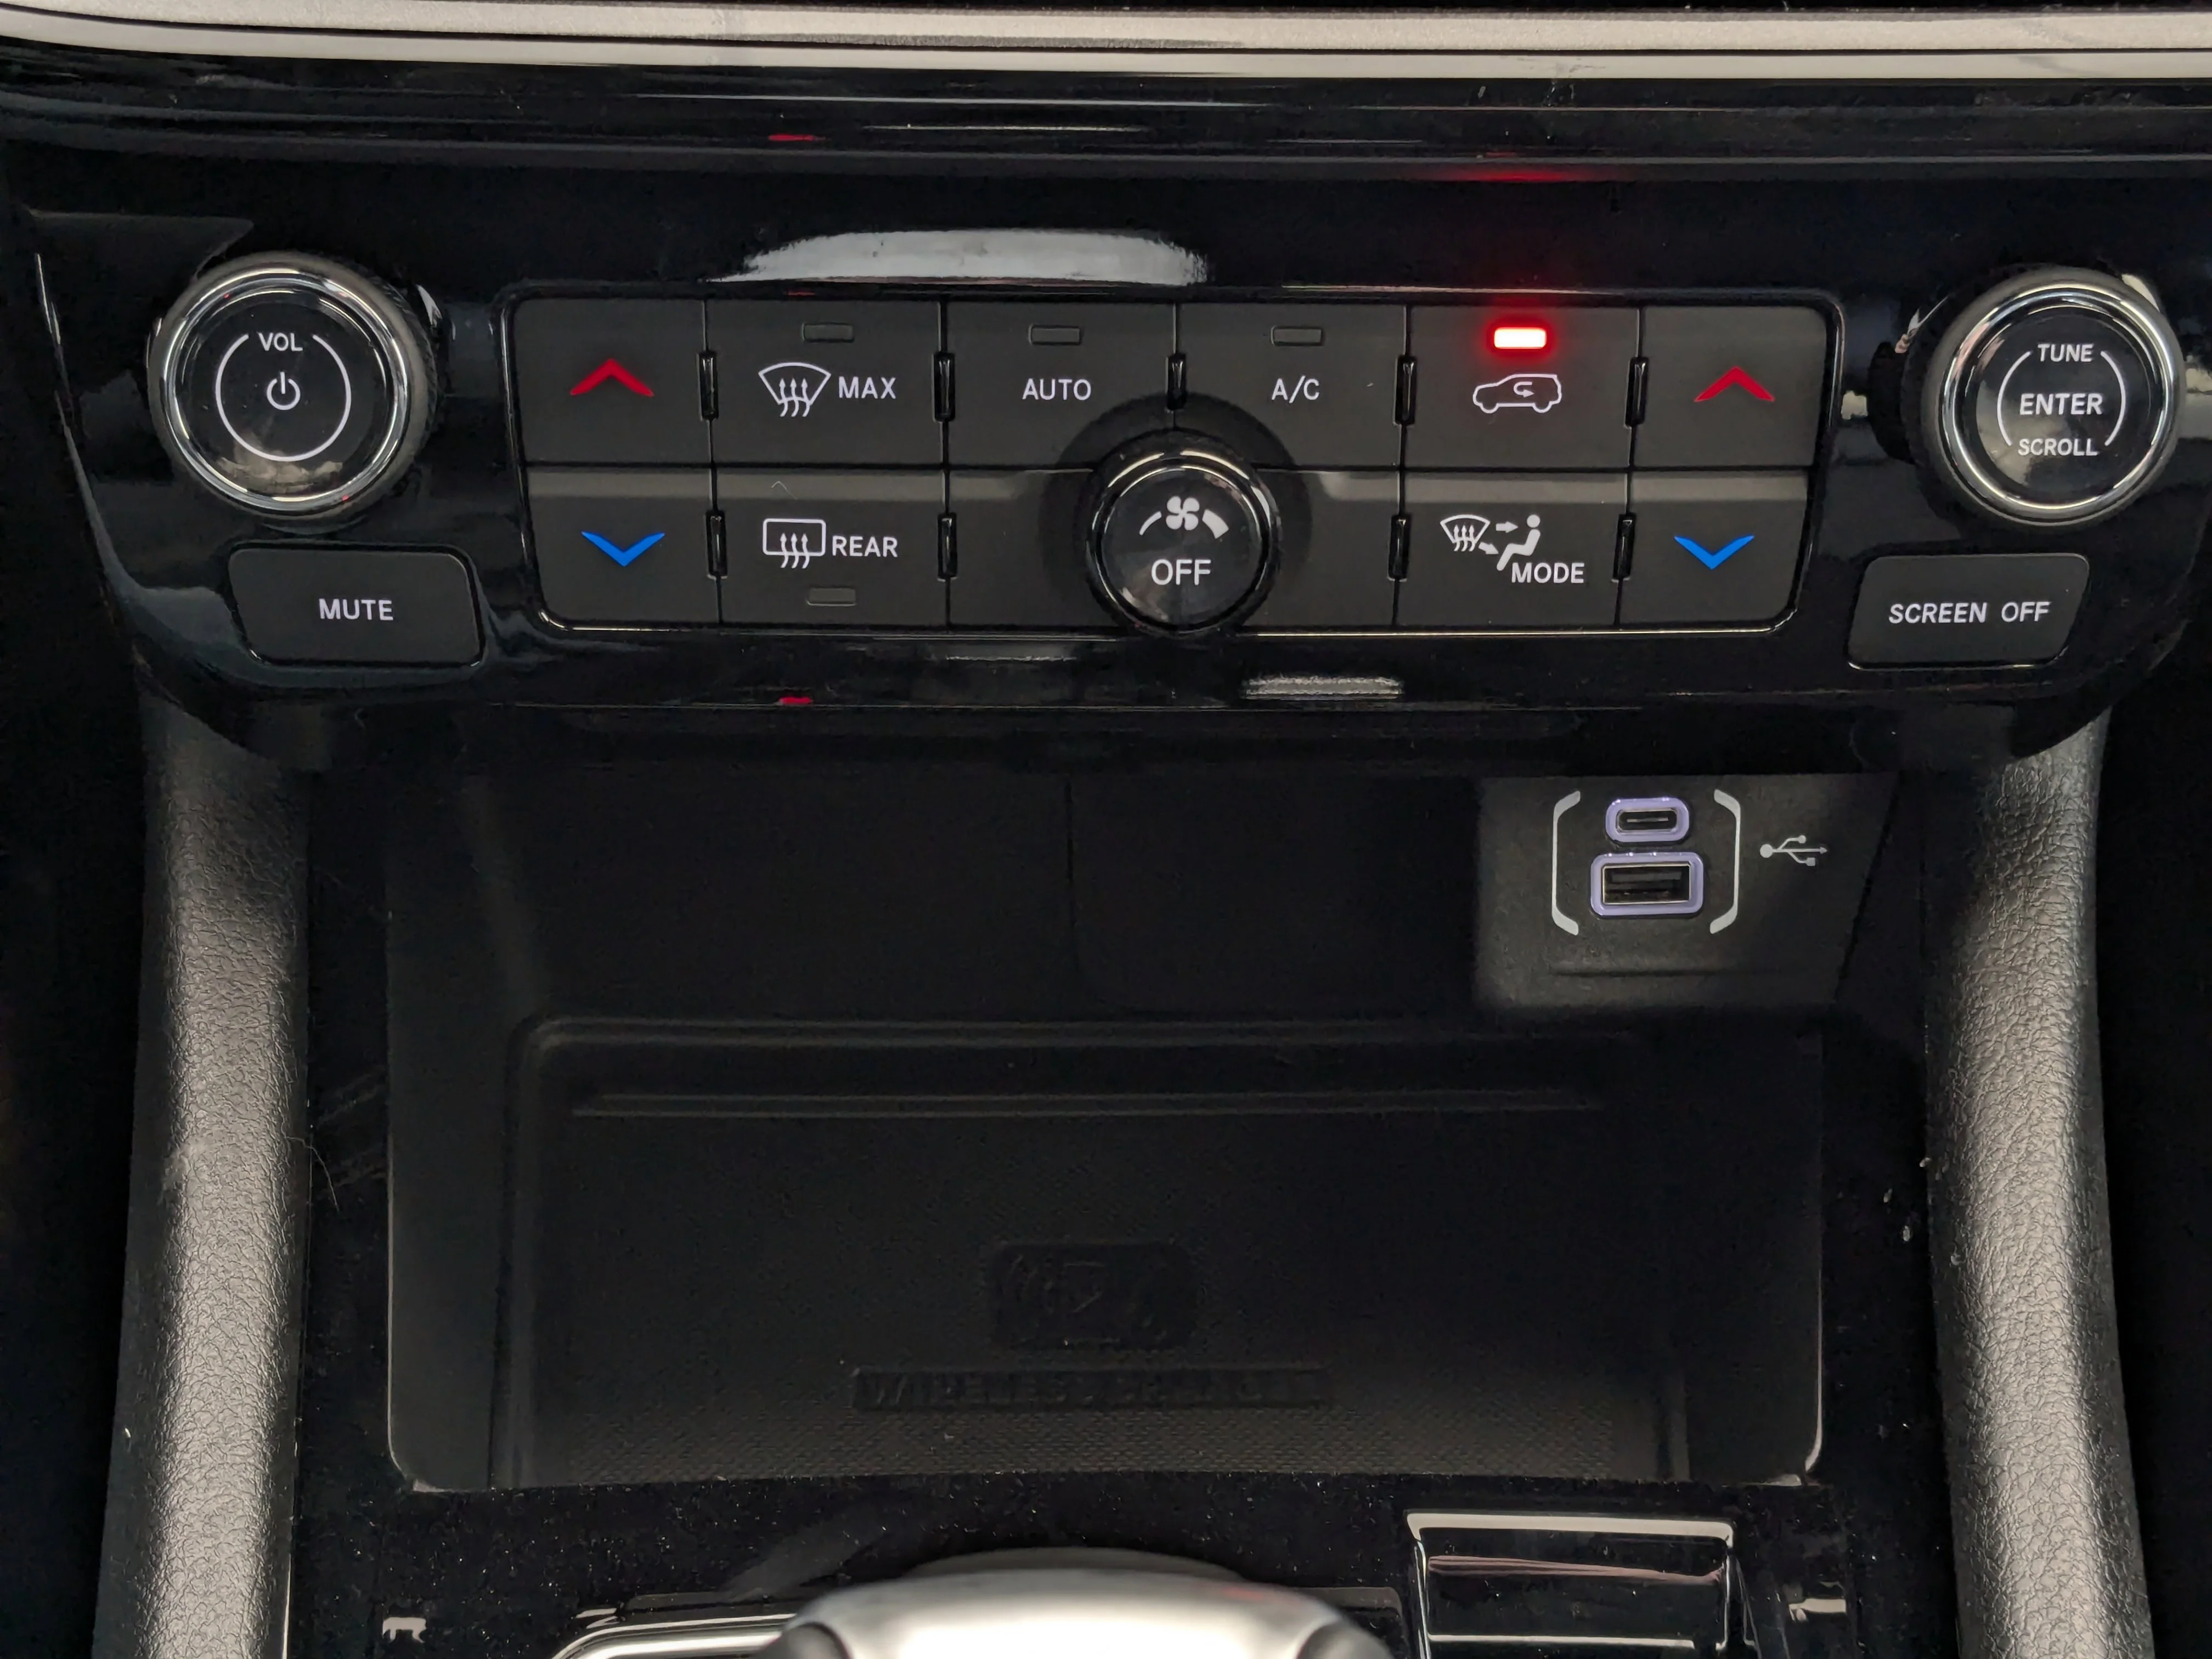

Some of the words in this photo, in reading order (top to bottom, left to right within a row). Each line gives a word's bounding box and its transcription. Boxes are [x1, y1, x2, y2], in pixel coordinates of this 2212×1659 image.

[258, 332, 303, 352] VOL
[2037, 343, 2094, 363] TUNE
[838, 376, 896, 399] MAX
[1022, 378, 1091, 400] AUTO
[1271, 375, 1320, 404] A/C
[2019, 392, 2103, 416] ENTER
[2017, 438, 2098, 457] SCROLL
[832, 535, 898, 558] REAR
[1151, 558, 1212, 585] OFF
[1511, 562, 1585, 584] MODE
[319, 597, 394, 621] MUTE
[1888, 602, 1988, 624] SCREEN
[2001, 601, 2051, 623] OFF
